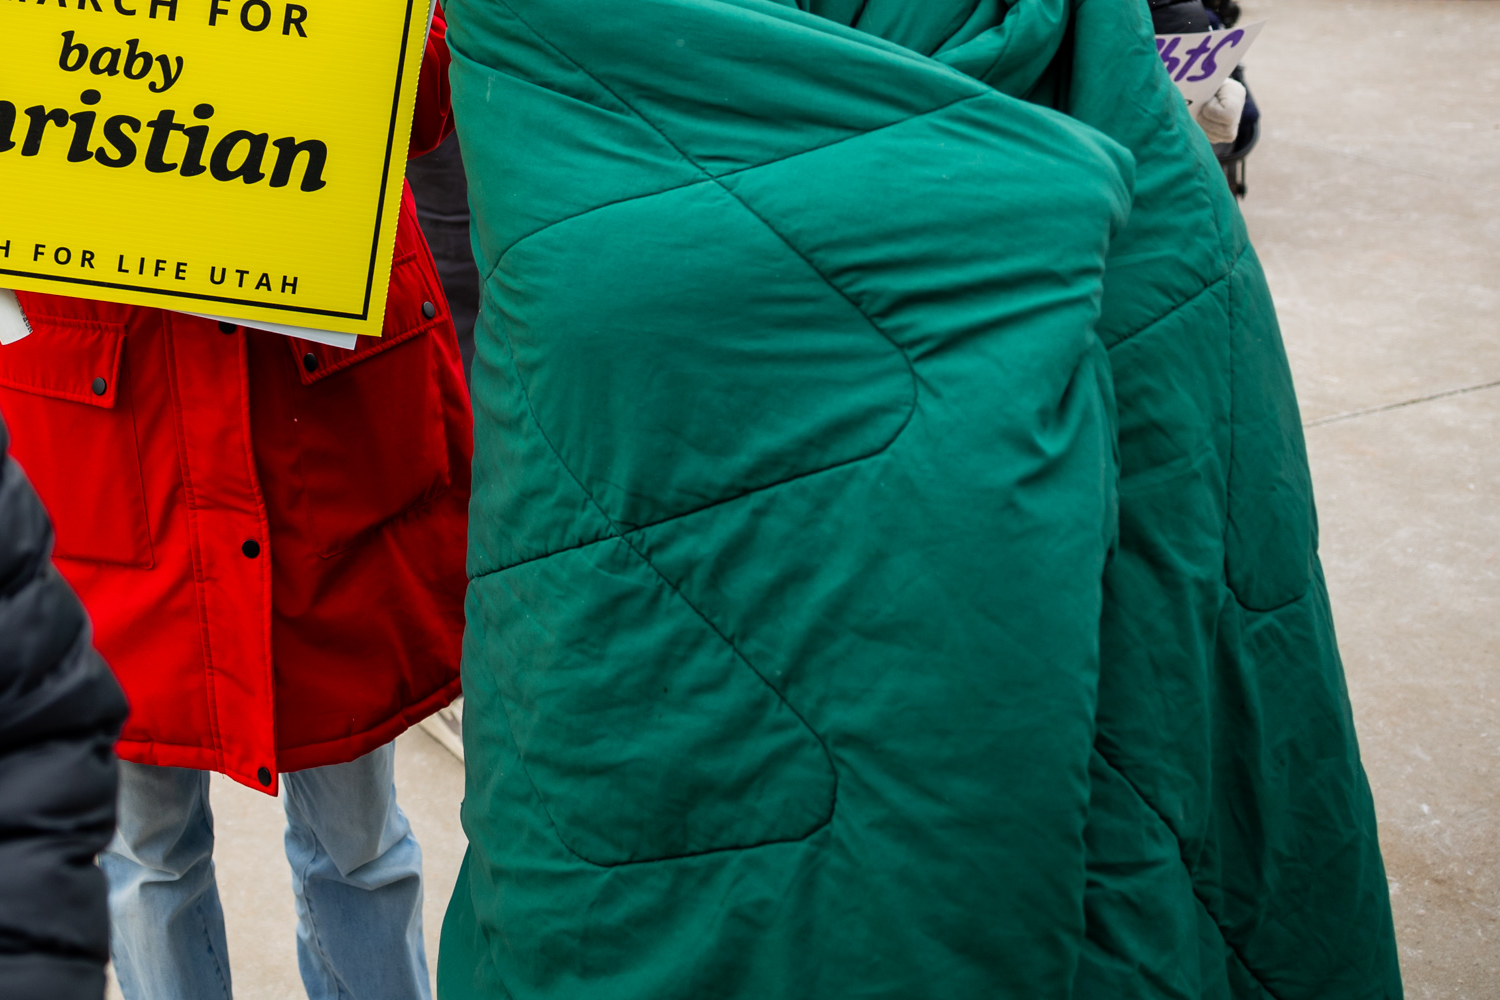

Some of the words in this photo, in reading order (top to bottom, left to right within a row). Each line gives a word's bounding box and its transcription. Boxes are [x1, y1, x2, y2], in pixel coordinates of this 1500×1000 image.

[58, 30, 184, 93] baby
[1156, 29, 1245, 82] hts
[33, 243, 95, 268] FOR
[117, 254, 188, 281] LIFE
[209, 266, 299, 295] UTAH
